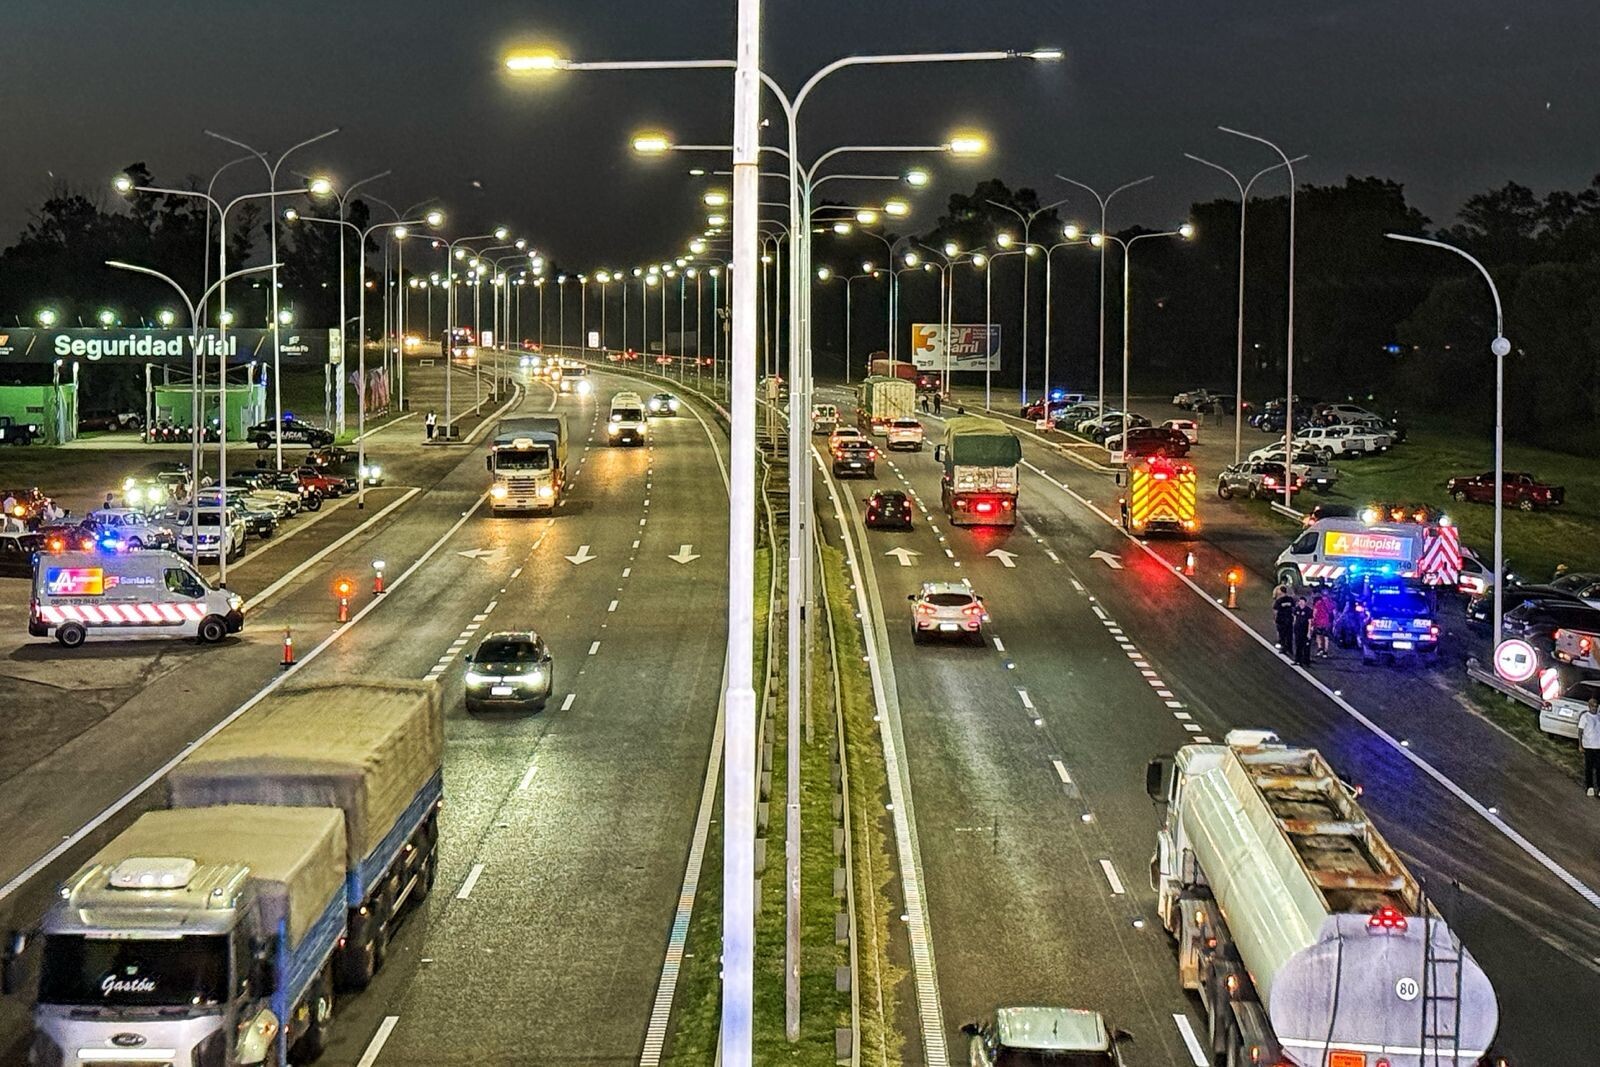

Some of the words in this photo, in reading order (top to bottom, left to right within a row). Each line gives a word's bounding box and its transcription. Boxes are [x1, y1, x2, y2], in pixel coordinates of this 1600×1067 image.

[54, 334, 182, 360] Seguridad
[188, 335, 237, 356] Vial
[1352, 536, 1401, 553] Autopista
[120, 576, 145, 584] Santa
[145, 576, 155, 584] Fe
[101, 974, 156, 996] Gastón
[1400, 982, 1415, 996] 80
